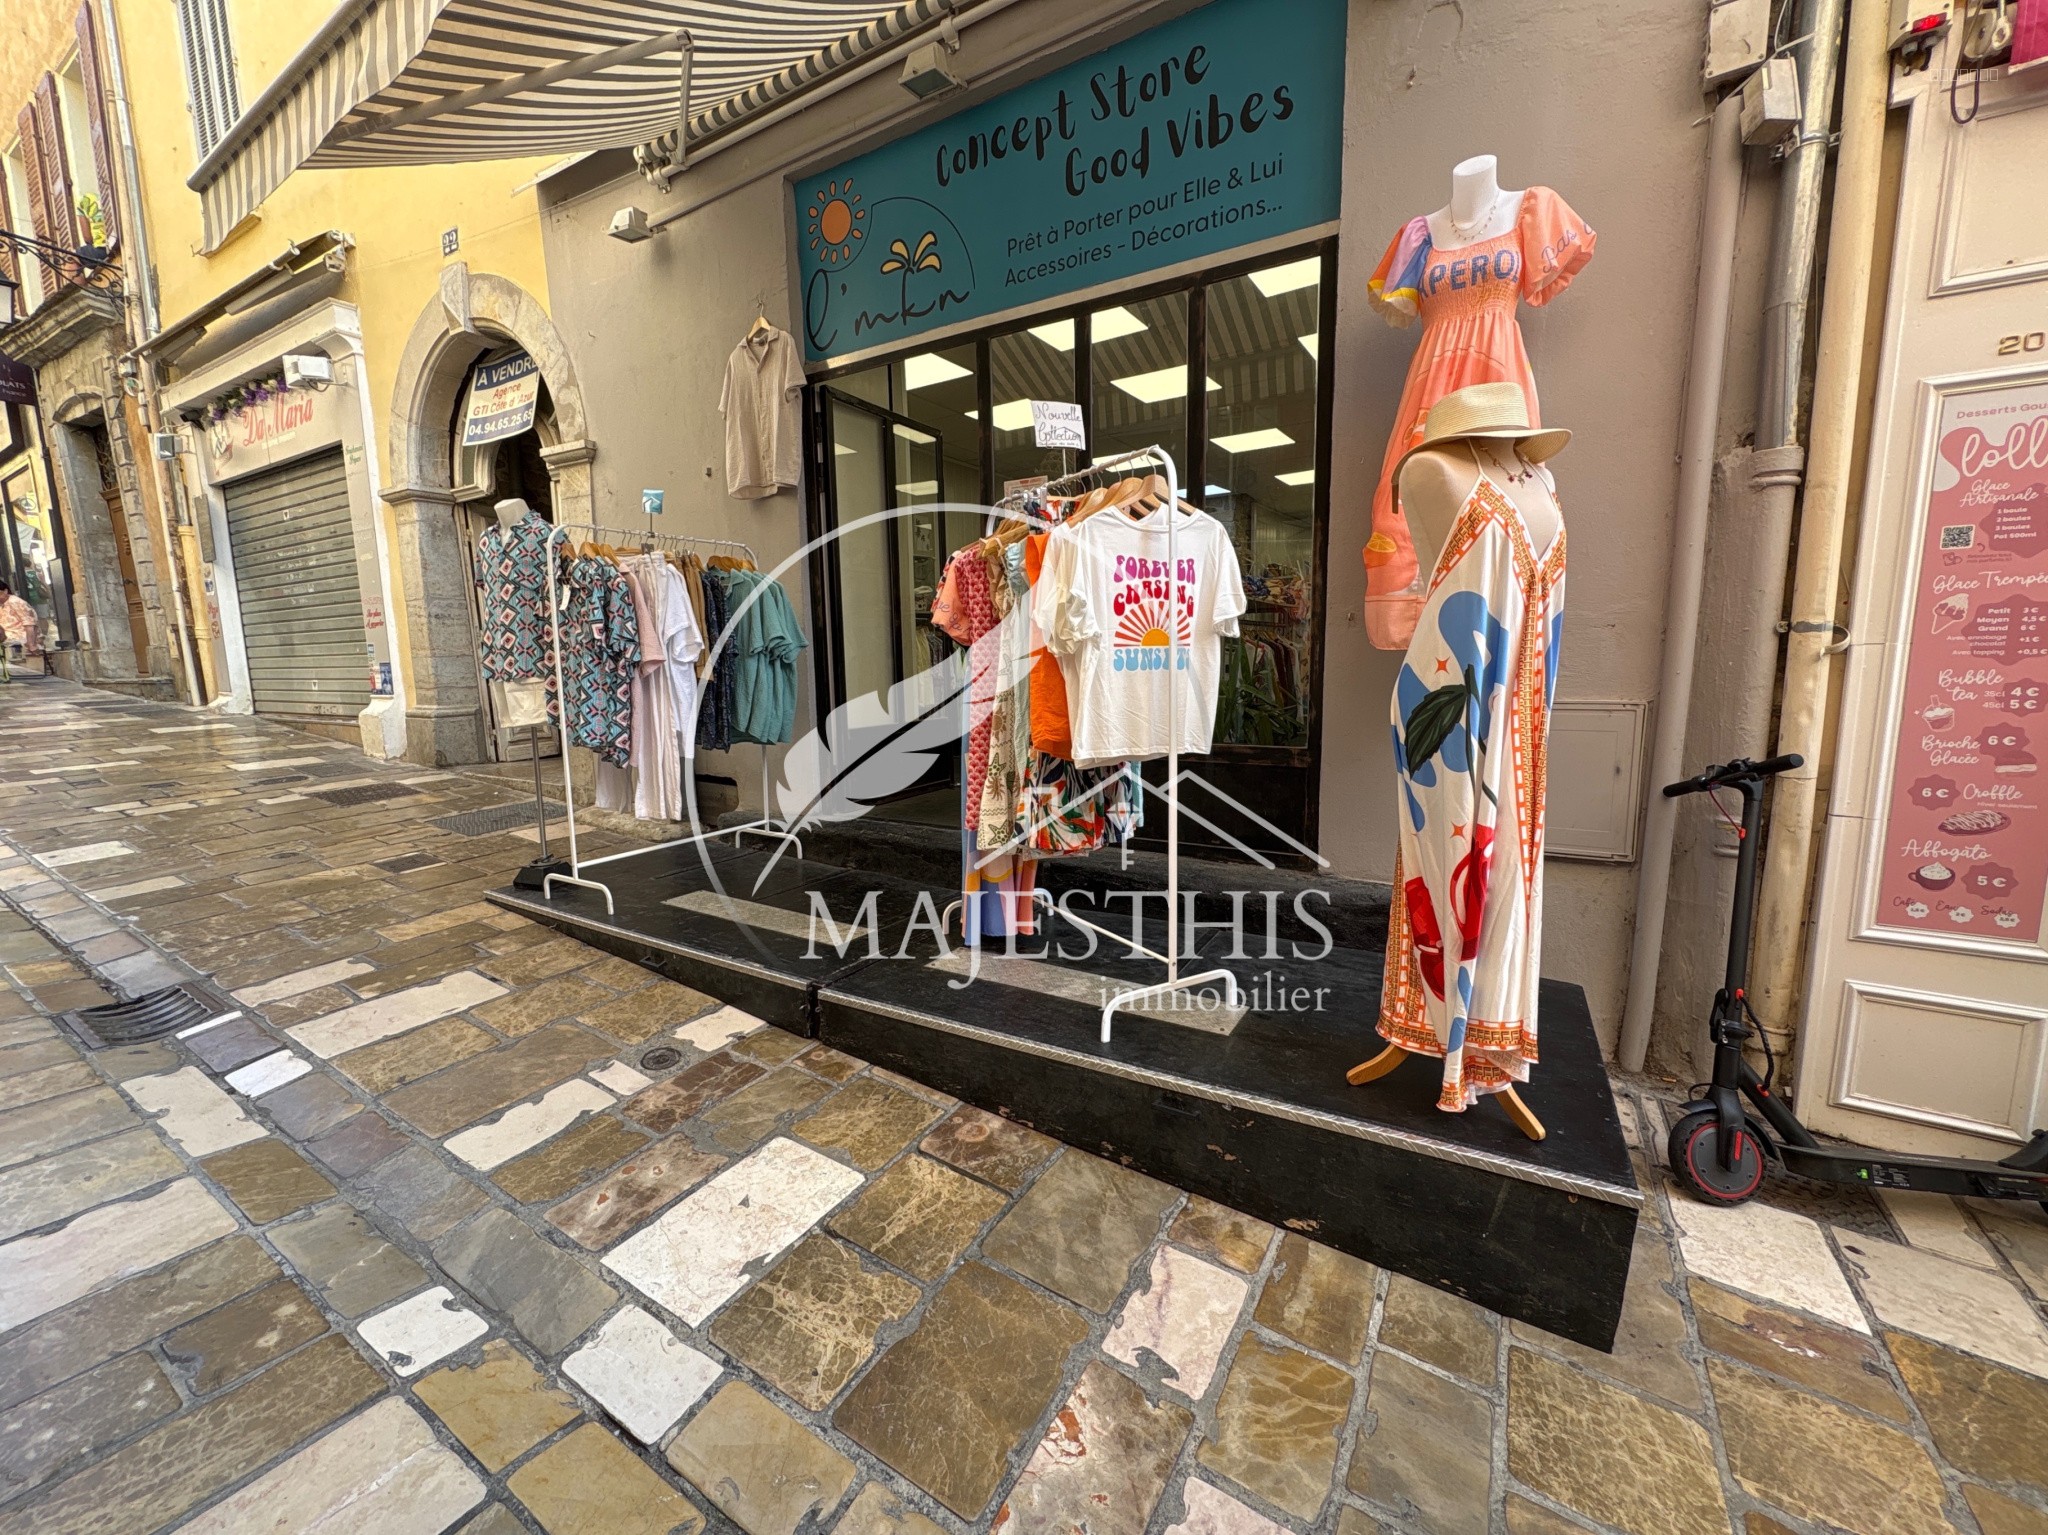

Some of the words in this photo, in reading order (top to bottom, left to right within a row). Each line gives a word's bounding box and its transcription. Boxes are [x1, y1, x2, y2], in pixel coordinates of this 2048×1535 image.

[936, 90, 1076, 187] Concept
[1090, 45, 1211, 122] Store
[1065, 126, 1150, 197] Good
[1166, 85, 1294, 158] Vibes
[1007, 229, 1042, 258] Prêt
[1046, 229, 1059, 245] à
[1064, 208, 1123, 240] Porter
[1128, 190, 1178, 224] pour
[1184, 177, 1222, 204] Elle
[1227, 167, 1244, 189] &
[1250, 153, 1284, 184] Lui
[1005, 241, 1112, 288] Accessoires
[1131, 198, 1283, 252] Décorations...
[1998, 332, 2046, 356] 20
[477, 368, 488, 386] À
[493, 383, 522, 399] Agence
[267, 391, 314, 437] Maria
[473, 404, 489, 417] GTI
[490, 401, 508, 413] Côte
[1036, 402, 1081, 420] Nouvelle
[1957, 406, 2017, 419] Desserts
[1971, 479, 2011, 495] Glace
[1959, 487, 2039, 507] Artisanale
[1932, 574, 1981, 594] Glace
[1938, 668, 2005, 688] Bubble
[1946, 686, 1978, 701] tea
[2010, 687, 2022, 696] 4
[2026, 687, 2040, 696] €
[2009, 699, 2020, 709] 5
[2023, 699, 2037, 709] €
[1922, 734, 1981, 751] Brioche
[1987, 735, 1999, 745] 6
[2002, 736, 2017, 746] €
[1930, 749, 1980, 767] Glacée
[1922, 787, 1932, 798] 6
[1935, 788, 1949, 798] €
[1963, 783, 2024, 800] Croffle
[1901, 838, 1992, 862] Affogato
[1976, 875, 1988, 886] 5
[1992, 877, 2007, 888] €
[1893, 896, 1916, 907] Café
